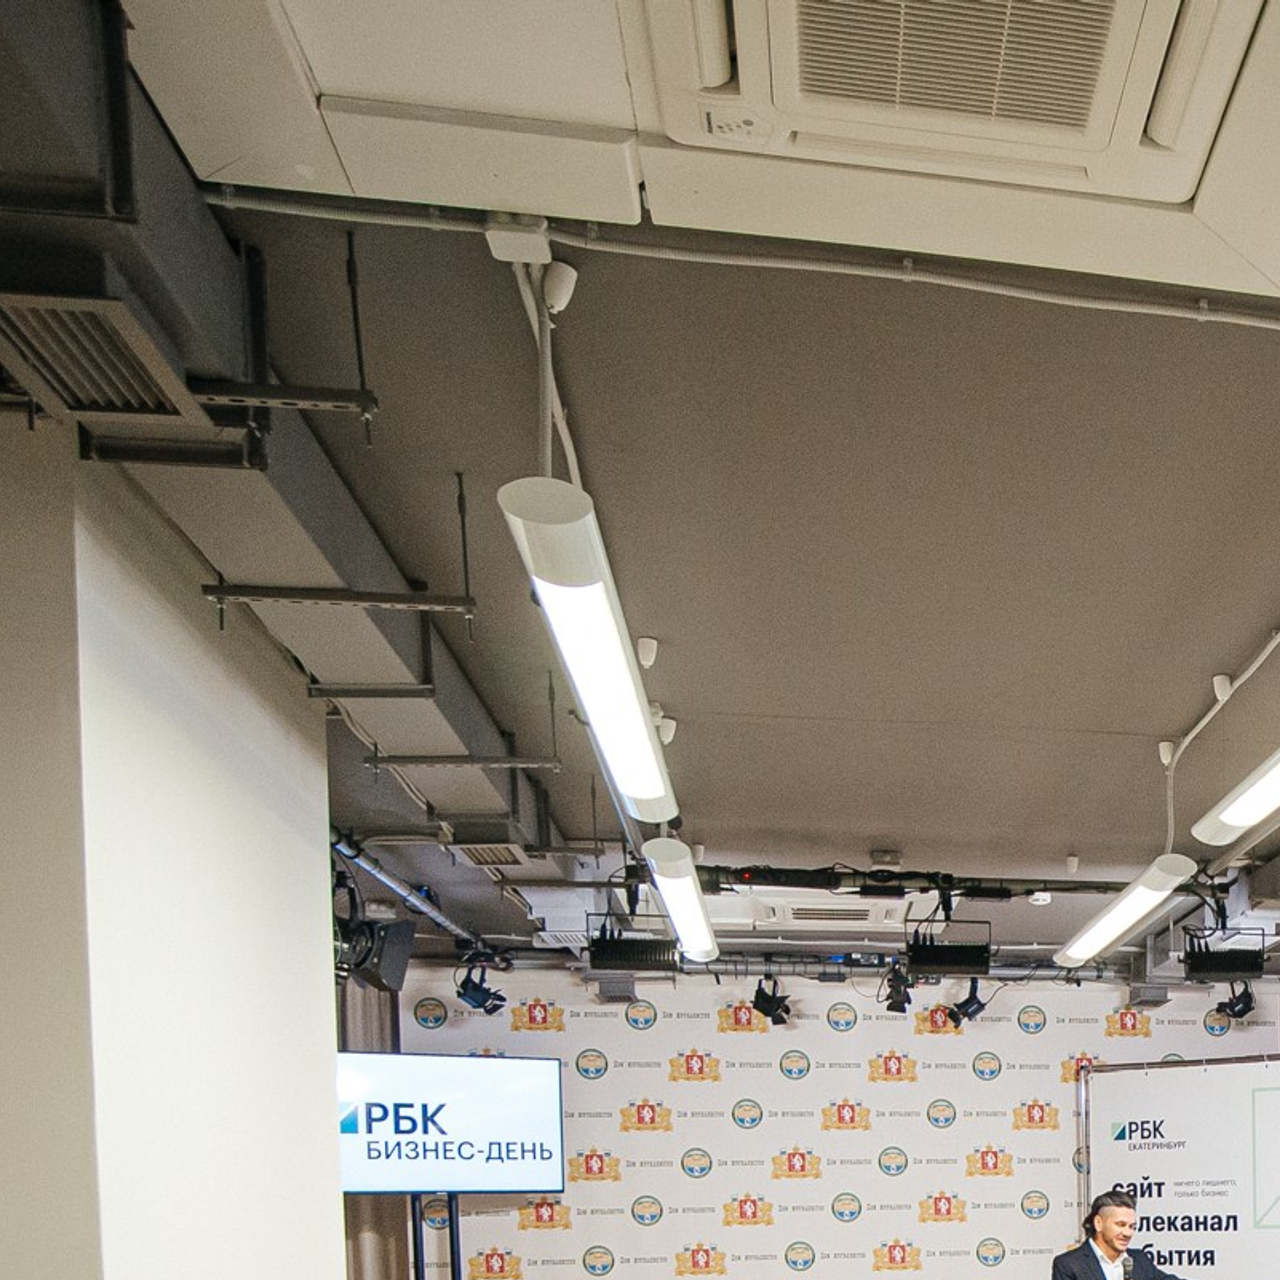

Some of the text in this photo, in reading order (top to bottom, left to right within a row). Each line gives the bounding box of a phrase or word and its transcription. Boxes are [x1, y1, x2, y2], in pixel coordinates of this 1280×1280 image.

[365, 1102, 448, 1135] РБК
[1128, 1119, 1165, 1140] РБК
[366, 1140, 554, 1164] БИЗНЕС-ДЕНЬ
[1128, 1141, 1186, 1151] ЕКАТЕРИНБУРГ
